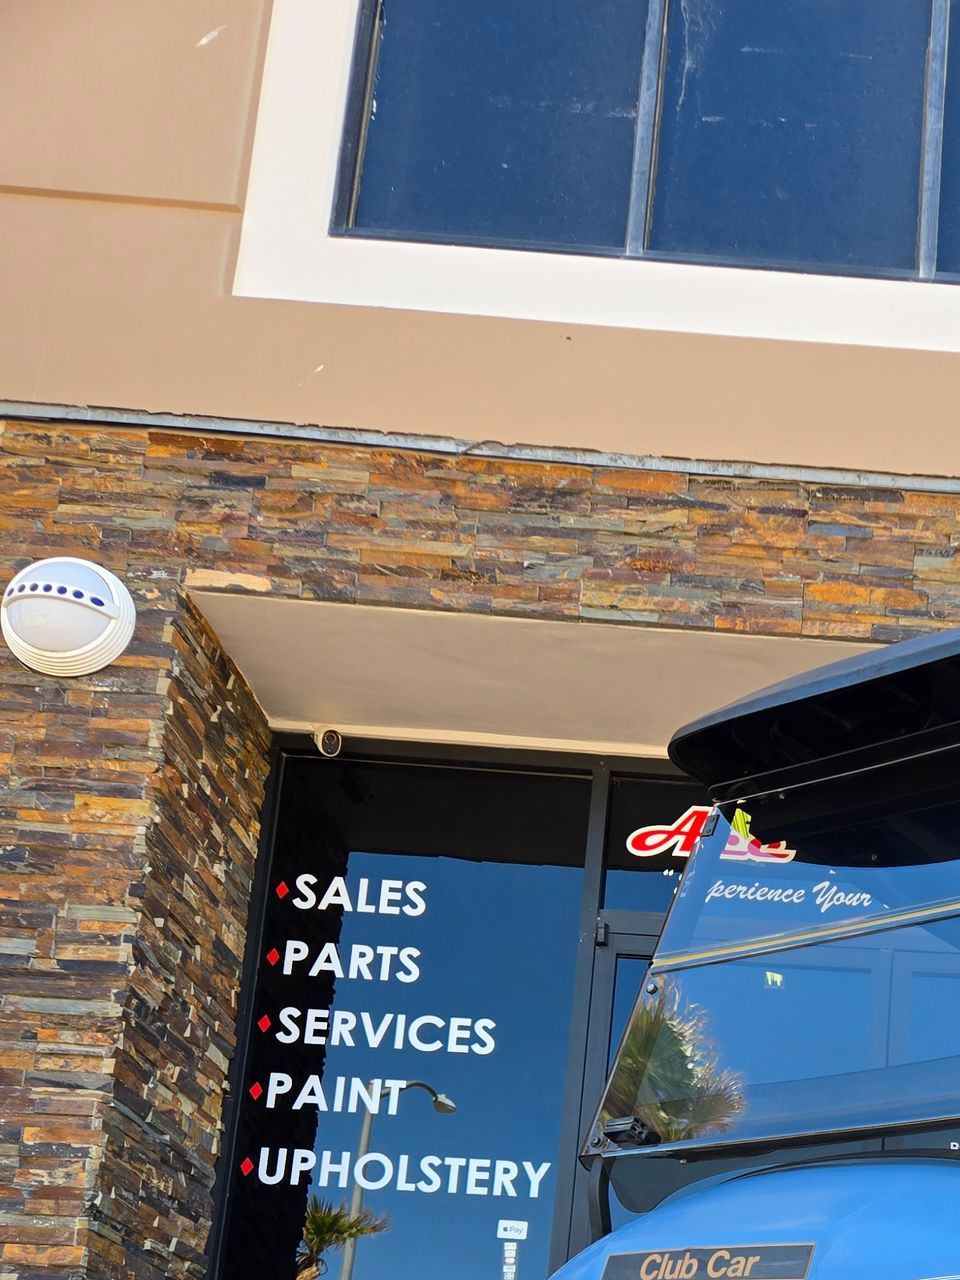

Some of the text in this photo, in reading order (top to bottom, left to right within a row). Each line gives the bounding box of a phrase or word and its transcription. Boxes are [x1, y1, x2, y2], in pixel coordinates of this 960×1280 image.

[292, 873, 427, 916] SALES
[705, 880, 872, 912] perience Your
[282, 940, 421, 983] PARTS
[275, 1006, 496, 1055] SERVICES
[266, 1072, 407, 1116] PAINT
[258, 1147, 551, 1198] UPHOLSTERY
[509, 1226, 524, 1236] Pay
[639, 1250, 761, 1280] Club Car
